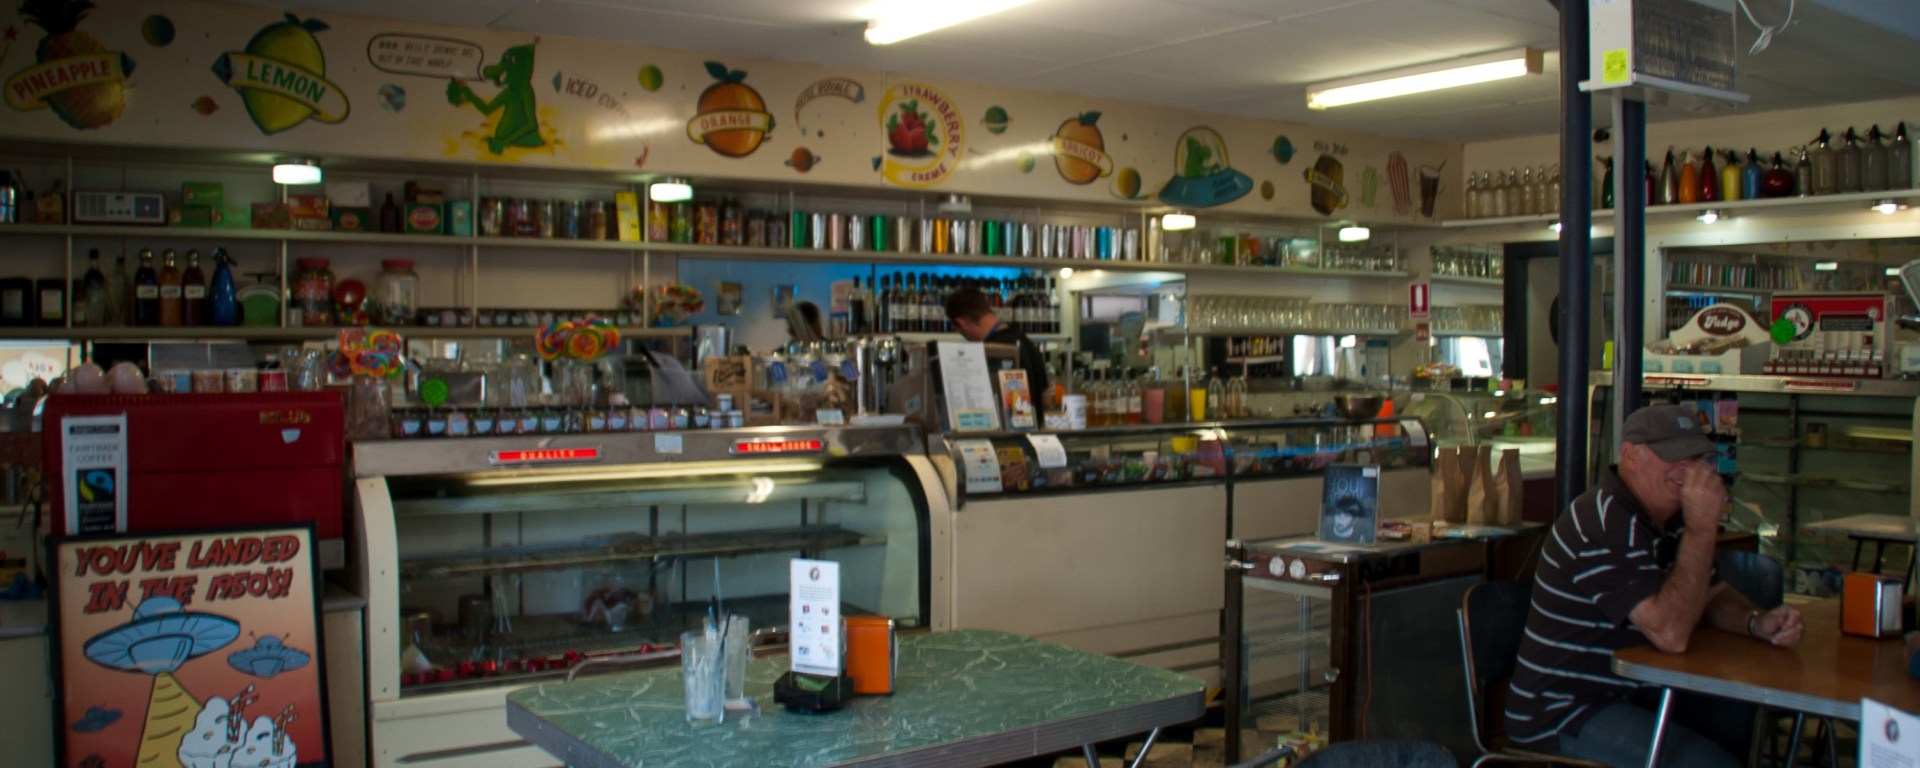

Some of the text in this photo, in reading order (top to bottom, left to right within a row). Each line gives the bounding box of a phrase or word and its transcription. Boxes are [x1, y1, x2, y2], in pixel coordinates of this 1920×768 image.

[11, 60, 112, 101] PINEAPPLE
[246, 59, 326, 103] LEMON
[565, 77, 598, 99] ICED
[700, 114, 751, 130] ORANGE
[902, 85, 961, 158] STRAWBERRY
[911, 162, 946, 182] CREME
[1703, 314, 1740, 331] Fudge
[69, 443, 119, 453] FAIRTRADE
[519, 449, 575, 461] QUALITY
[747, 442, 782, 452] SMALL
[76, 454, 113, 464] COFFEE
[74, 535, 301, 576] YOU'VE LANDED
[82, 567, 294, 615] IN THE 1950'S!
